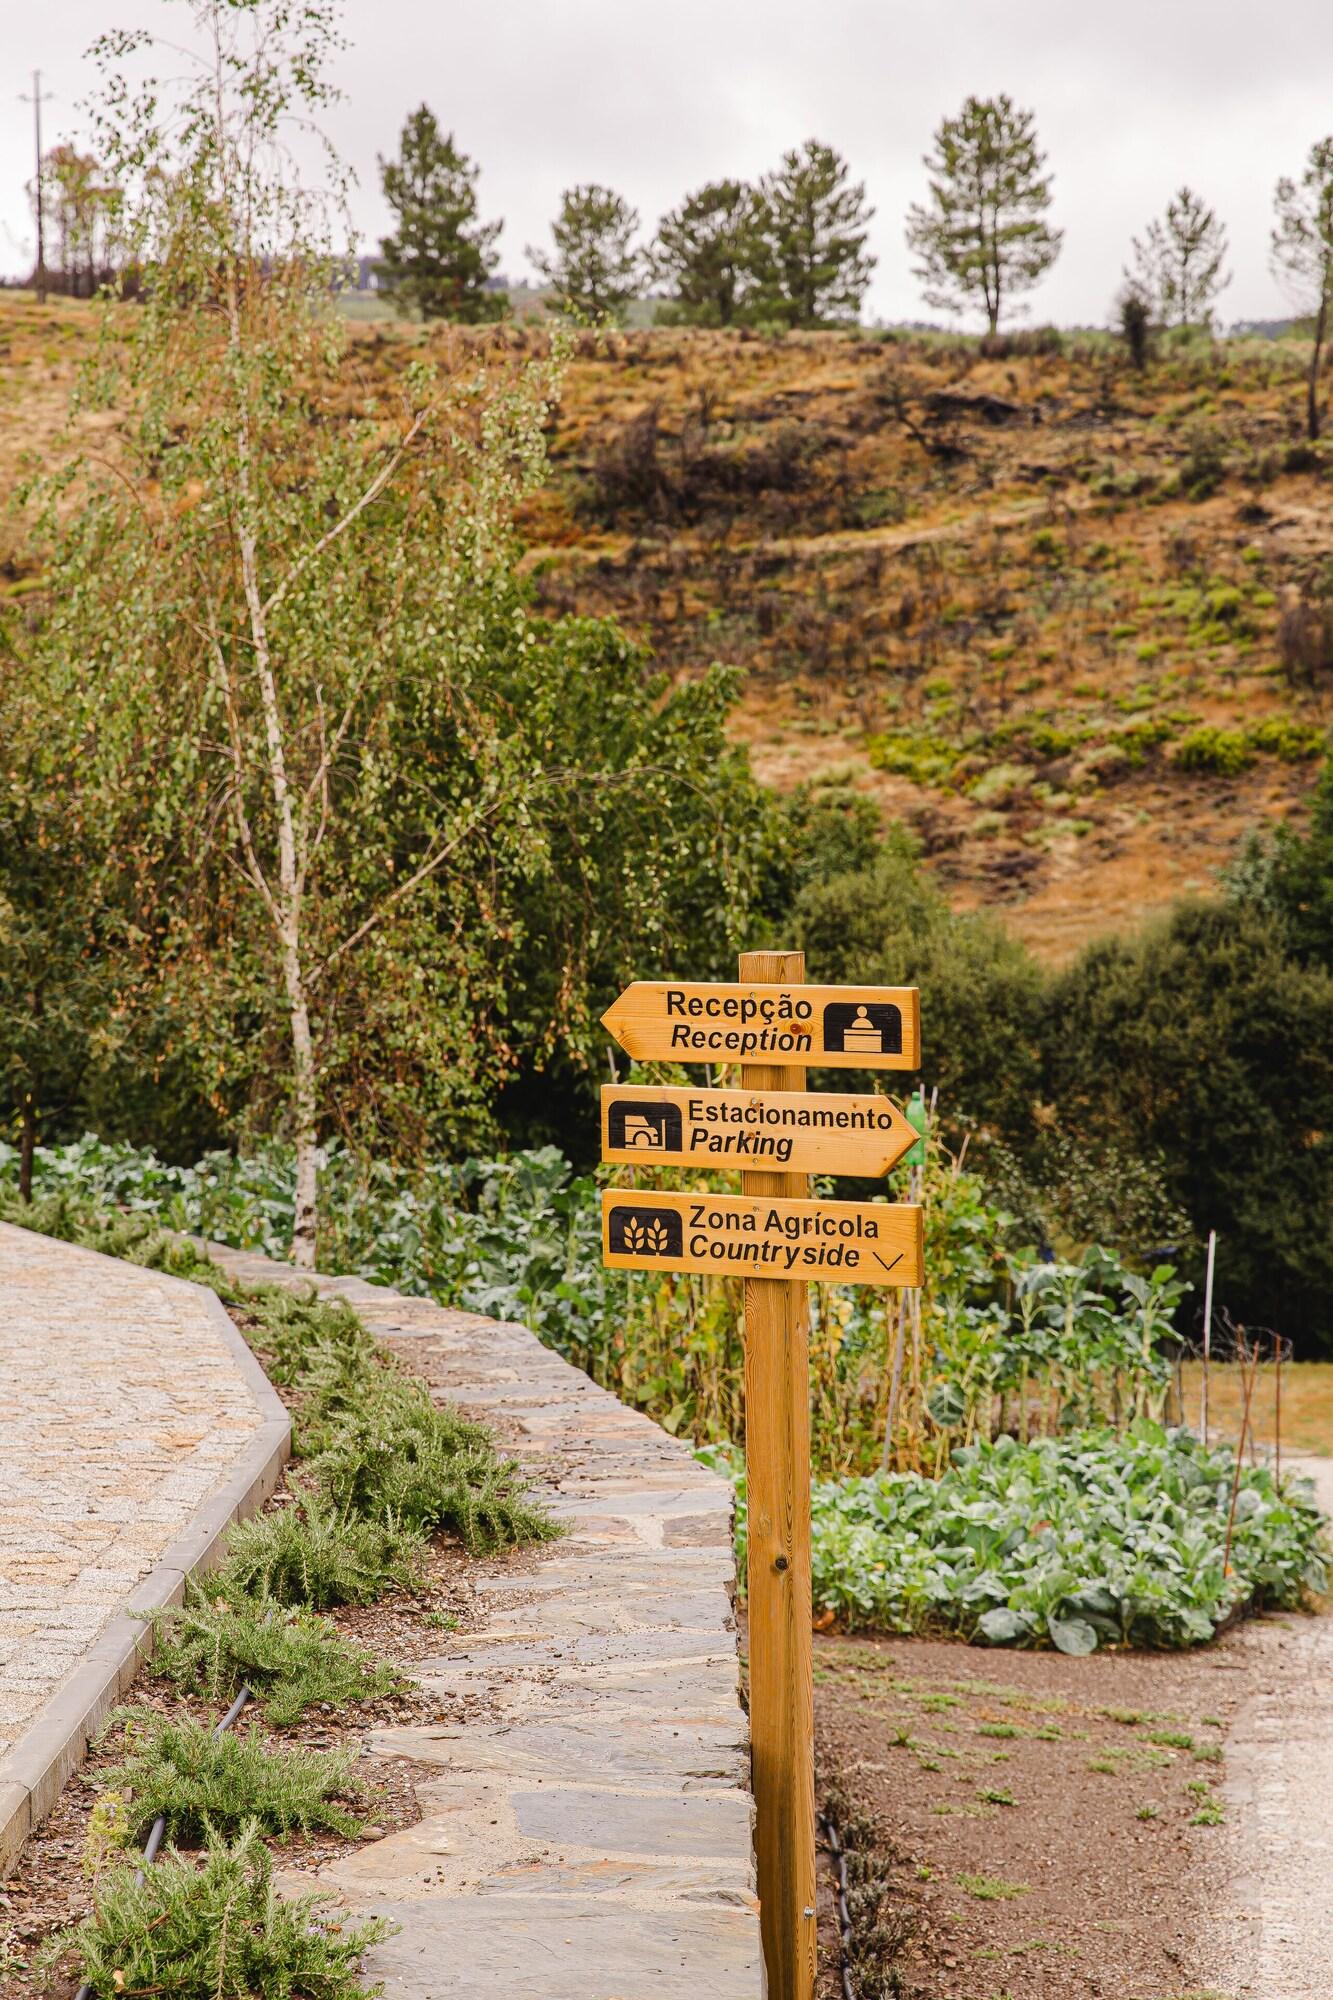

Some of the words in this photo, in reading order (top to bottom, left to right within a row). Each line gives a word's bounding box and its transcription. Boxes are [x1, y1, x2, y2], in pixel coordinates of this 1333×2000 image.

[667, 991, 812, 1024] Recepção
[671, 1025, 812, 1055] Reception
[689, 1100, 892, 1130] Estacionamento
[690, 1128, 793, 1162] Parking
[689, 1205, 756, 1230] Zona
[764, 1210, 878, 1239] Agrícola
[690, 1235, 859, 1269] Countryside
